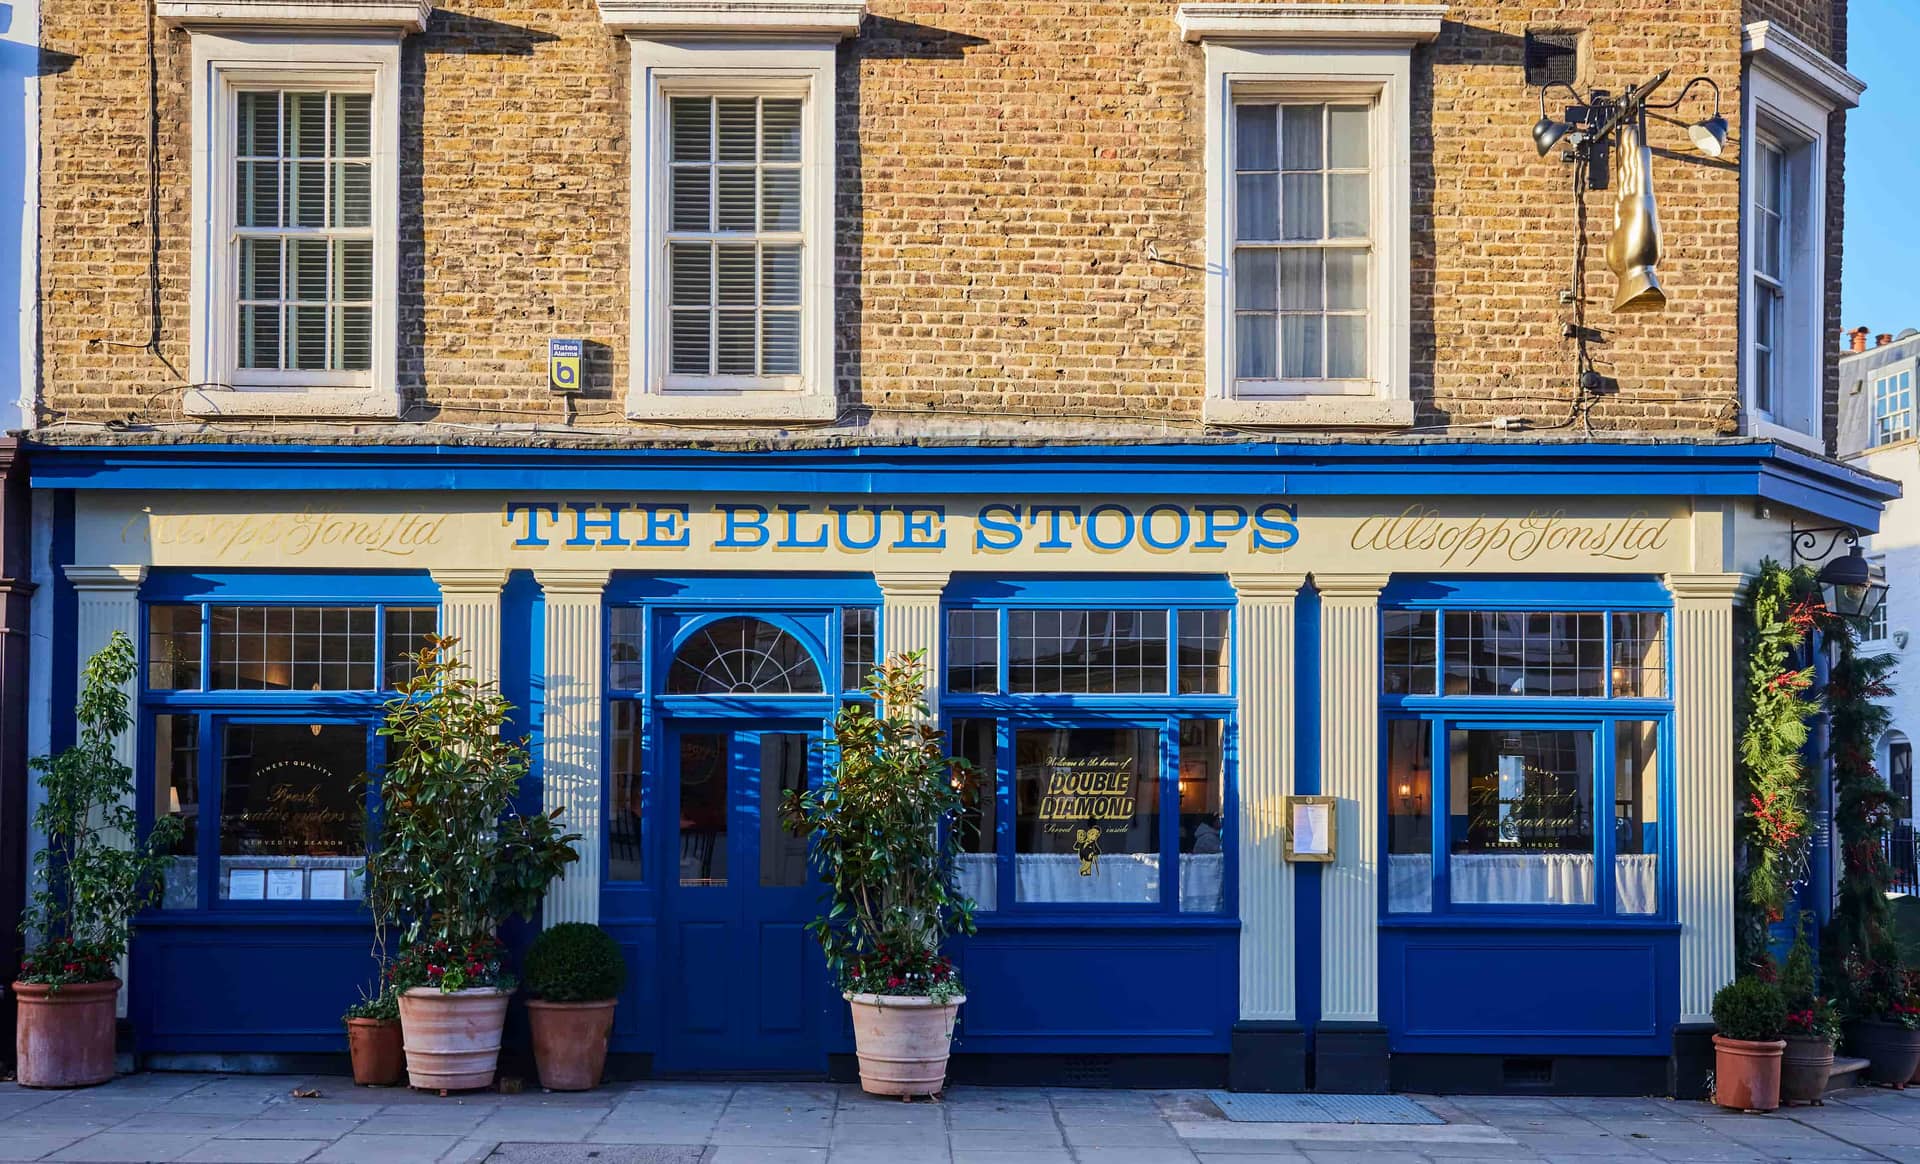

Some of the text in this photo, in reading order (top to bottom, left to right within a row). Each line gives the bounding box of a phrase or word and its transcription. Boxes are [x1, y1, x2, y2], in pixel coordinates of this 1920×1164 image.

[553, 343, 578, 351] Bates
[502, 502, 1300, 554] THE BLUE STOOPS
[1350, 503, 1510, 567] Allsopp
[1589, 509, 1673, 560] Ltd
[256, 761, 333, 777] FINEST QUALITY
[1087, 757, 1099, 767] the
[1119, 757, 1133, 770] of
[1047, 771, 1131, 795] DOUBLE
[1038, 796, 1136, 820] DIAMOND
[243, 839, 344, 847] SERVED IN SEASON
